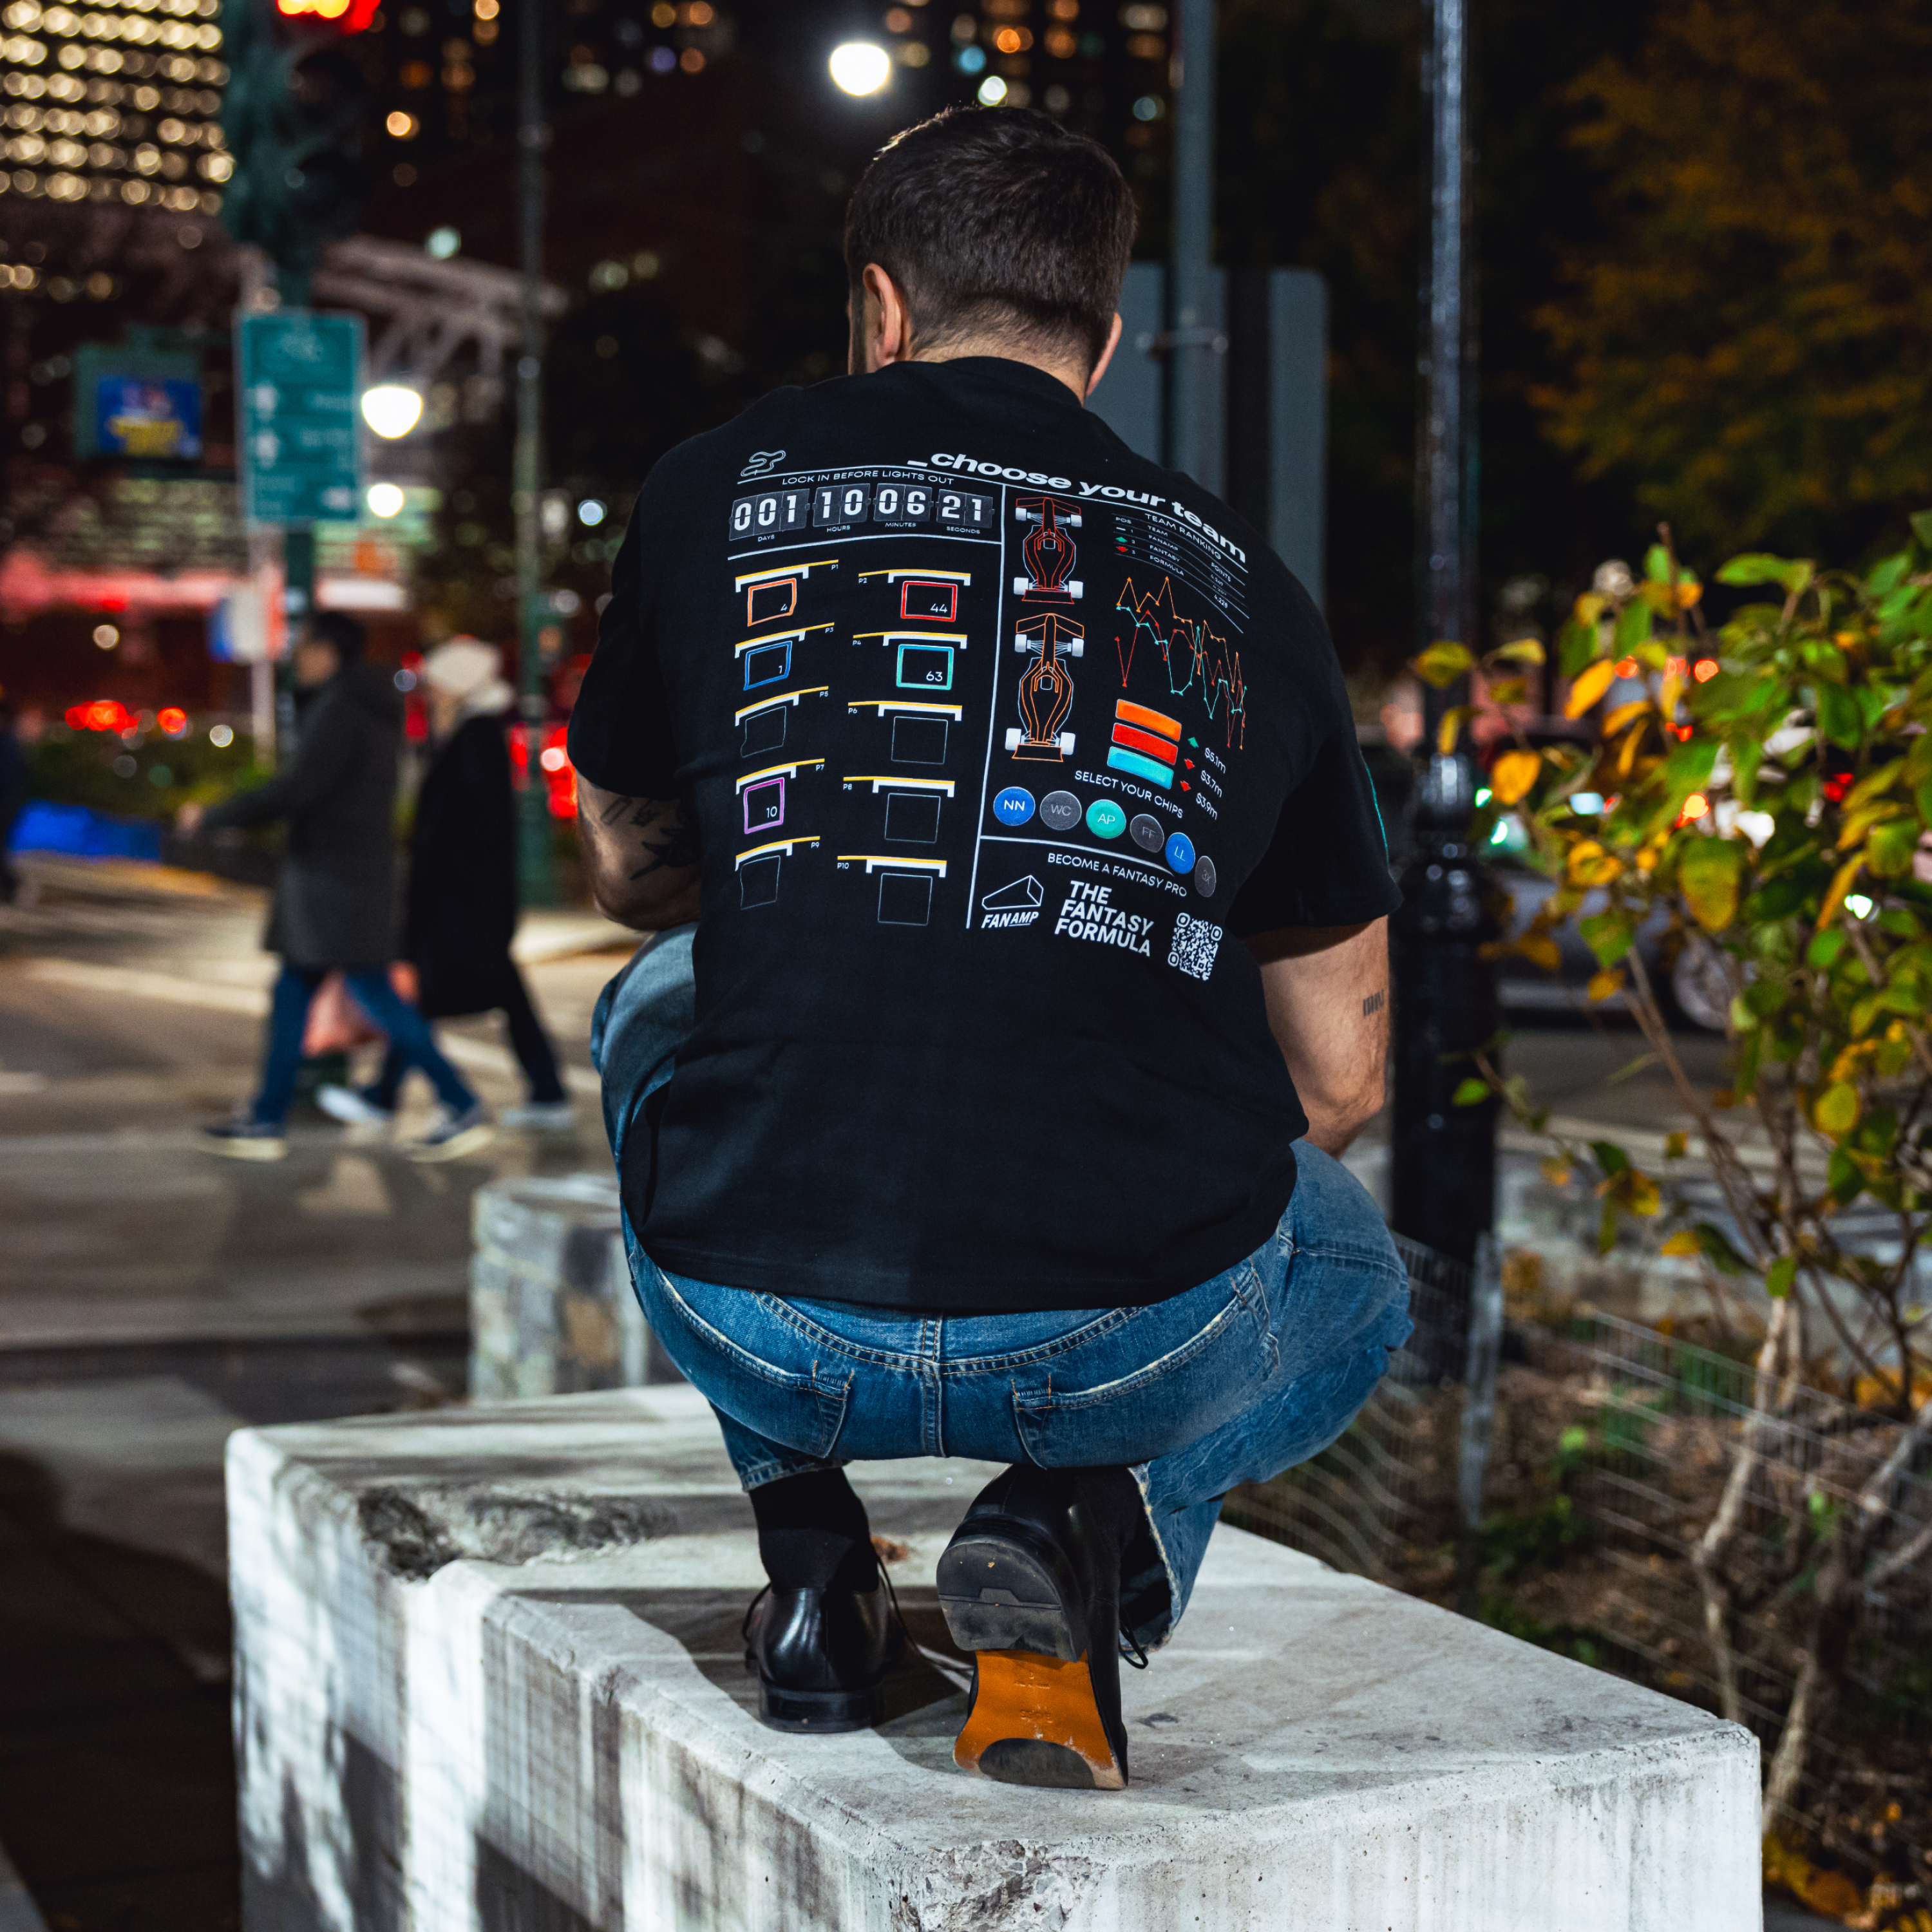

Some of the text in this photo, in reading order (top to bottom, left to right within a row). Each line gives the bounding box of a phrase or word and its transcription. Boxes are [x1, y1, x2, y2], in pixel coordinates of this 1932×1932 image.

[782, 470, 954, 485] LOCK IN BEFORE LIGHTS OUT
[734, 489, 983, 531] 001 10 06 21
[1078, 481, 1166, 507] your
[1171, 500, 1245, 564] team
[1145, 513, 1221, 560] TEAM RANKING
[1148, 526, 1168, 536] TEAM
[1211, 562, 1231, 582] POINTS
[1150, 545, 1180, 562] FANTASY
[1150, 555, 1184, 576] FORMULA
[930, 603, 947, 613] 44
[926, 672, 943, 682] 63
[1205, 747, 1226, 773] $5.1m
[1075, 770, 1184, 819] SELECT YOUR CHIPS
[1201, 770, 1222, 798] $3.7m
[766, 806, 777, 818] 10
[1004, 800, 1025, 811] NN
[1050, 804, 1071, 817] WC
[1196, 792, 1217, 820] $3.9m
[1097, 813, 1115, 825] AP
[1142, 826, 1156, 838] FF
[1175, 846, 1185, 861] LL
[1048, 853, 1188, 897] BECOME A FANTASY PRO
[1070, 880, 1112, 905] THE
[981, 911, 1039, 929] FANAMP
[1060, 900, 1155, 936] FANTASY
[1054, 918, 1151, 958] FORMULA
